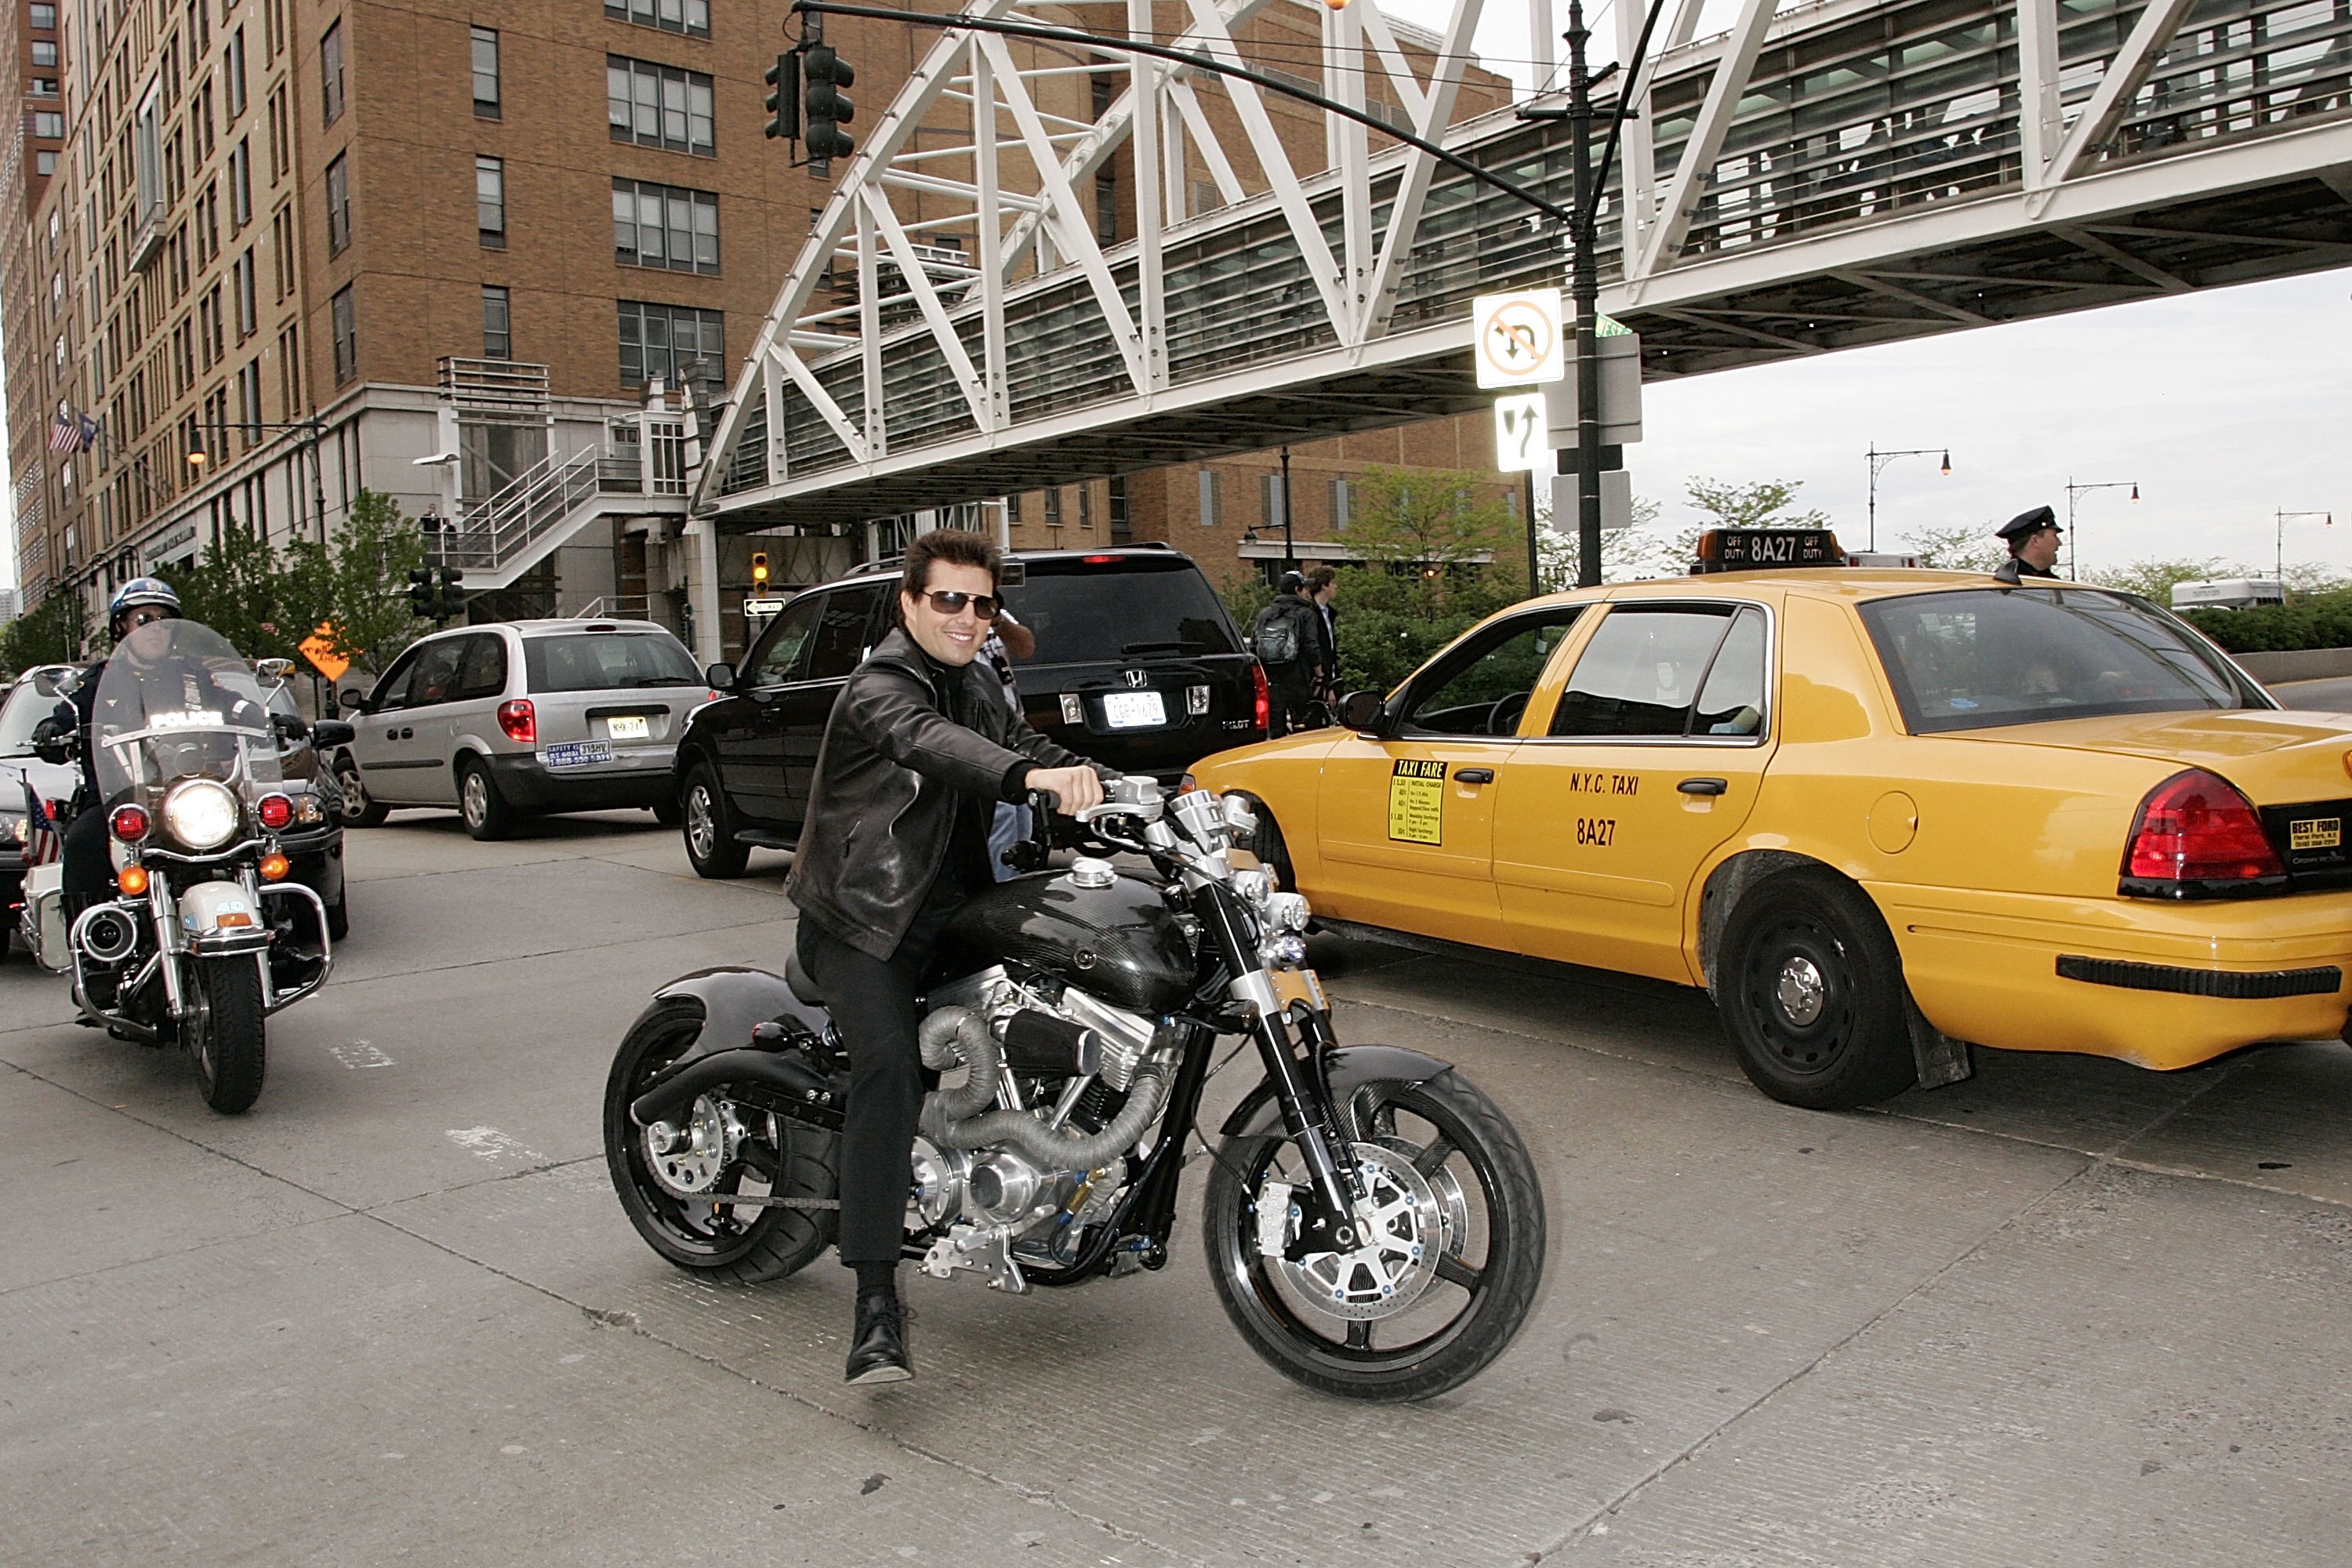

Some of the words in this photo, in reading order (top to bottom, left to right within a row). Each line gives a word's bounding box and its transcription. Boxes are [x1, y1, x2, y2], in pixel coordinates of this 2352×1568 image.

[1727, 535, 1743, 546] OFF
[1751, 536, 1796, 561] 8A27
[1804, 535, 1820, 546] OFF
[1725, 549, 1745, 559] DUTY
[1803, 549, 1823, 559] DUTY
[150, 711, 224, 729] POLICE
[1398, 760, 1419, 776] TAXI
[1420, 762, 1444, 778] FARE
[1570, 772, 1605, 793] N.Y.C.
[1612, 775, 1639, 795] TAXI
[1577, 818, 1615, 847] 8A27
[2292, 822, 2314, 833] BEST
[2317, 819, 2339, 832] FORD
